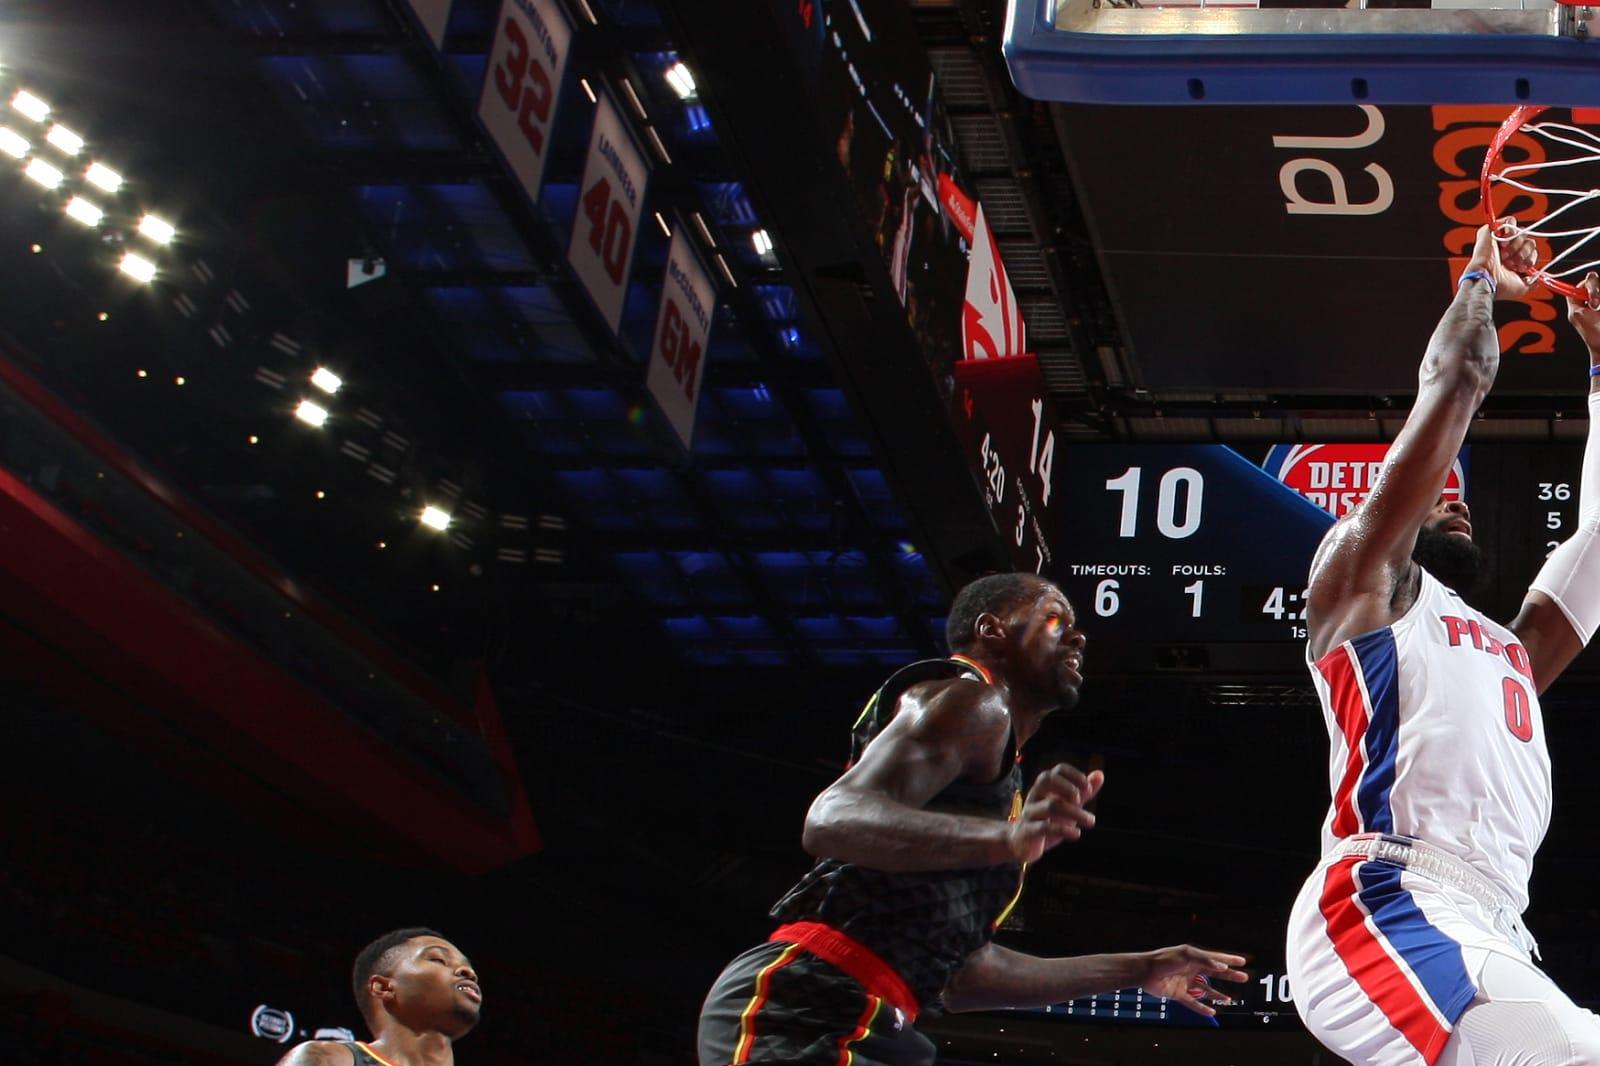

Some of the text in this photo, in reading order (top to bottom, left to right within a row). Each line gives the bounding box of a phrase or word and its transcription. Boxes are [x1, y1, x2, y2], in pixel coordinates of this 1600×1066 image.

[495, 17, 553, 157] 32
[581, 178, 631, 286] 40
[659, 298, 701, 404] GM
[982, 432, 1005, 503] 4:20
[1030, 398, 1054, 507] 14
[1105, 466, 1204, 539] 10
[1538, 483, 1571, 500] 36
[1546, 512, 1561, 529] 5
[1071, 564, 1226, 576] TIMEOUTS: FOULS:
[1094, 579, 1203, 618] 6 1
[1291, 627, 1306, 639] 1s
[1502, 677, 1533, 742] 0
[1260, 974, 1294, 1002] 10
